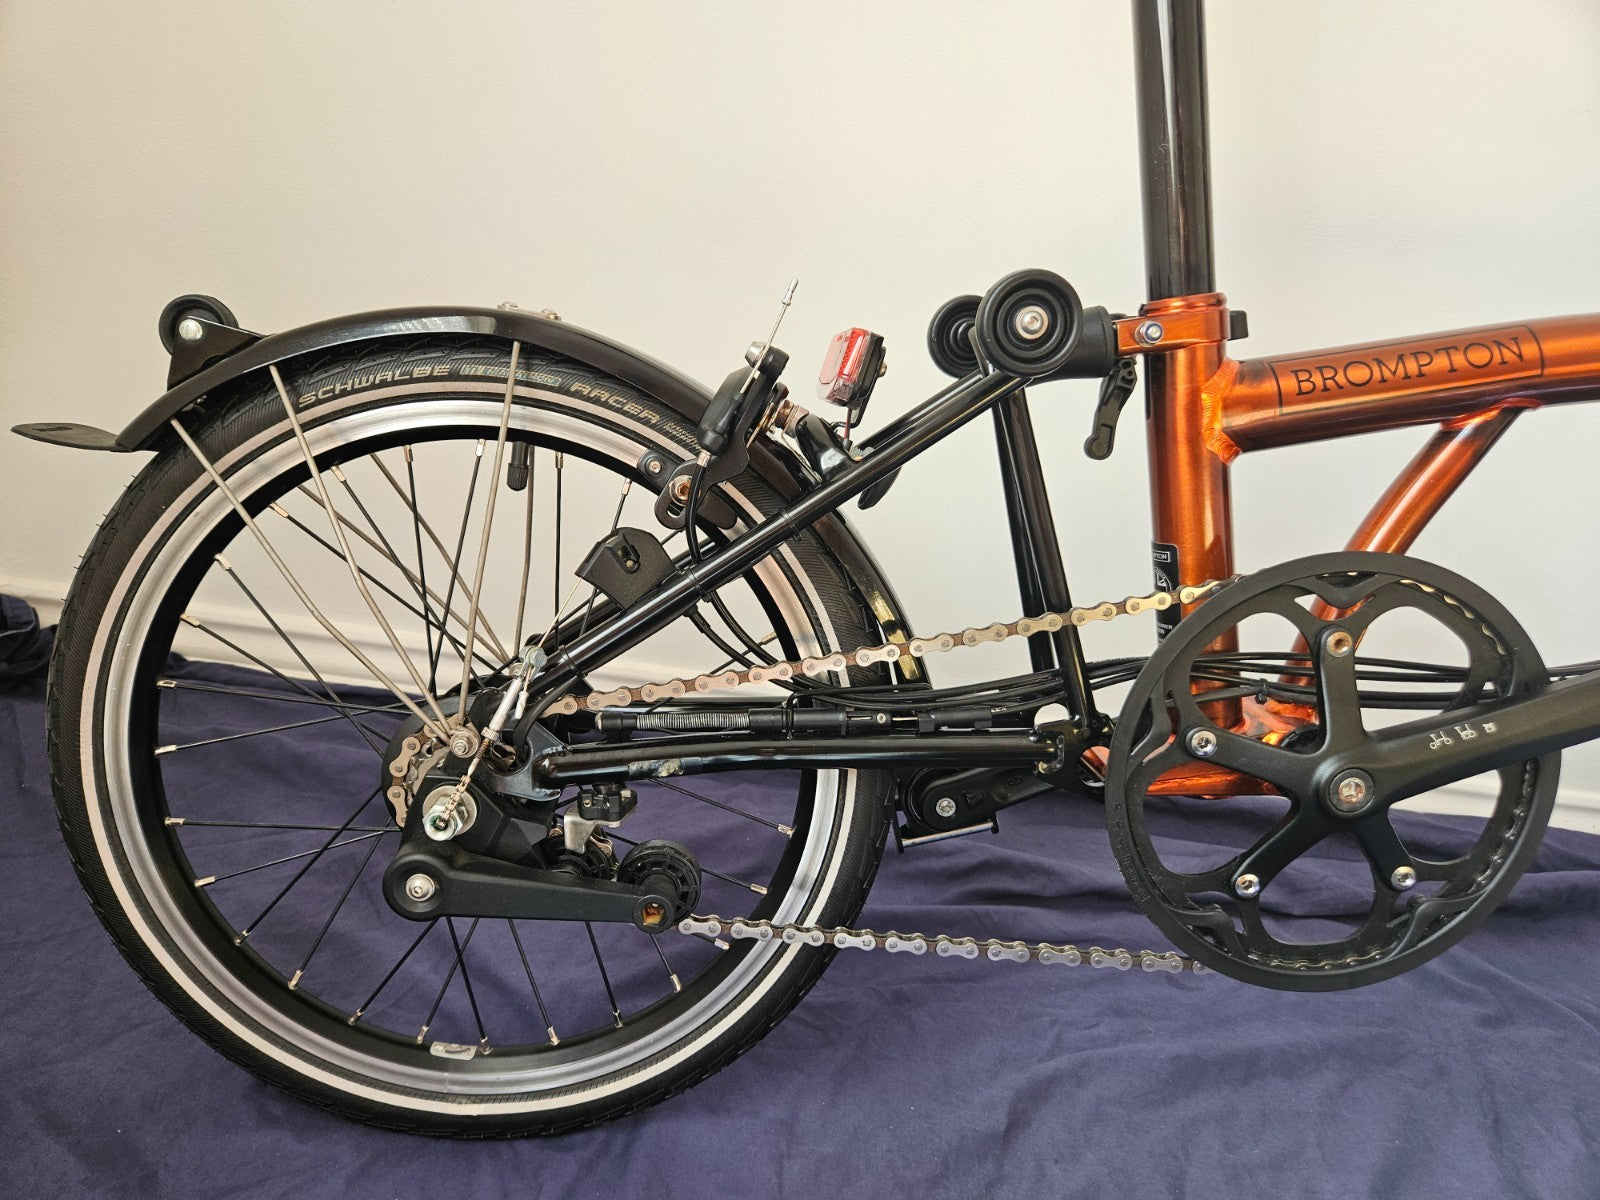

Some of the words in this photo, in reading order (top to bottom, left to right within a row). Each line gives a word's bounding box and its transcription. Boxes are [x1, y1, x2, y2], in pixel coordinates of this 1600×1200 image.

[298, 364, 451, 408] SCHWALBE
[569, 381, 661, 424] RACER
[1290, 336, 1524, 397] BROMPTON
